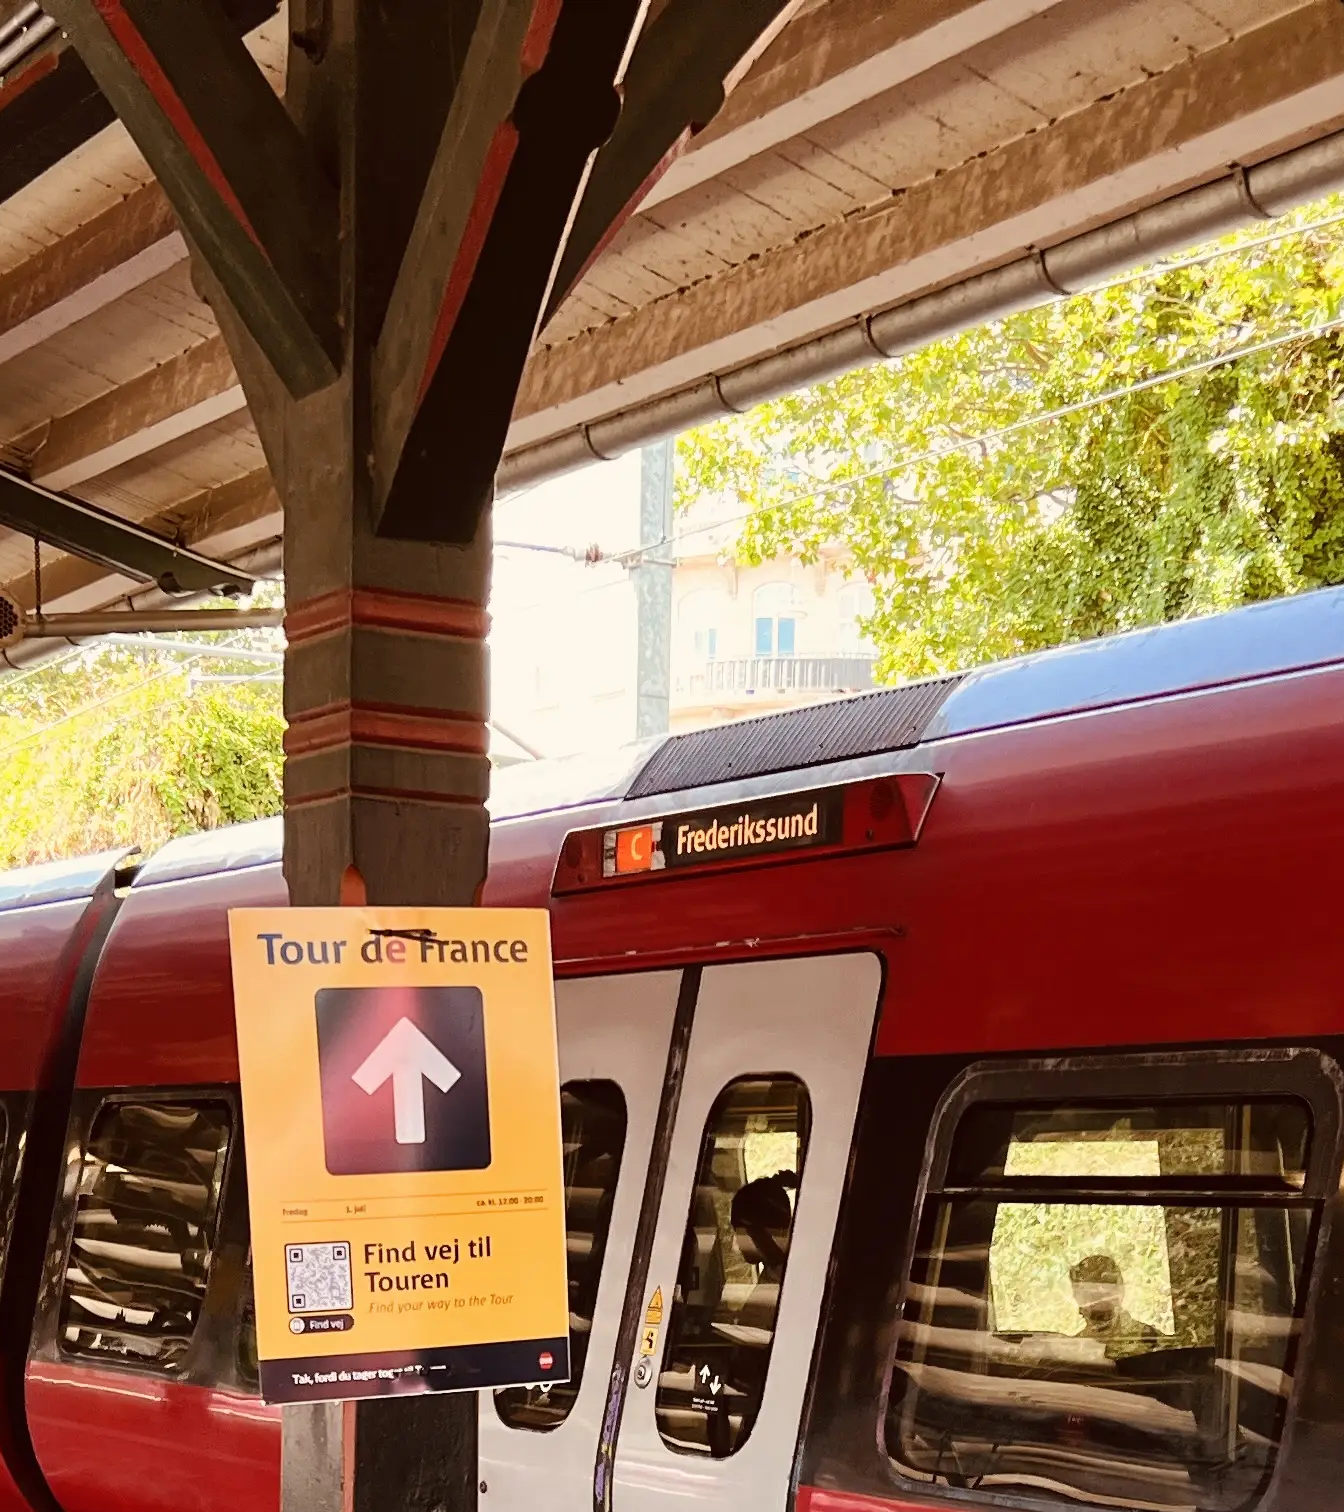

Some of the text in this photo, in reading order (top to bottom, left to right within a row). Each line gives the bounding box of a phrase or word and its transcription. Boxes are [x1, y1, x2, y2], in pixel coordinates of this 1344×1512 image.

[631, 802, 818, 861] C Frederikssund
[257, 933, 529, 965] Tour de France
[364, 1235, 491, 1264] Find vej til
[363, 1271, 449, 1293] Touren
[368, 1293, 514, 1314] Find your way to the Tour
[309, 1318, 344, 1331] Find vej
[291, 1373, 314, 1386] Tak,
[314, 1371, 337, 1383] fordi
[338, 1370, 352, 1381] du
